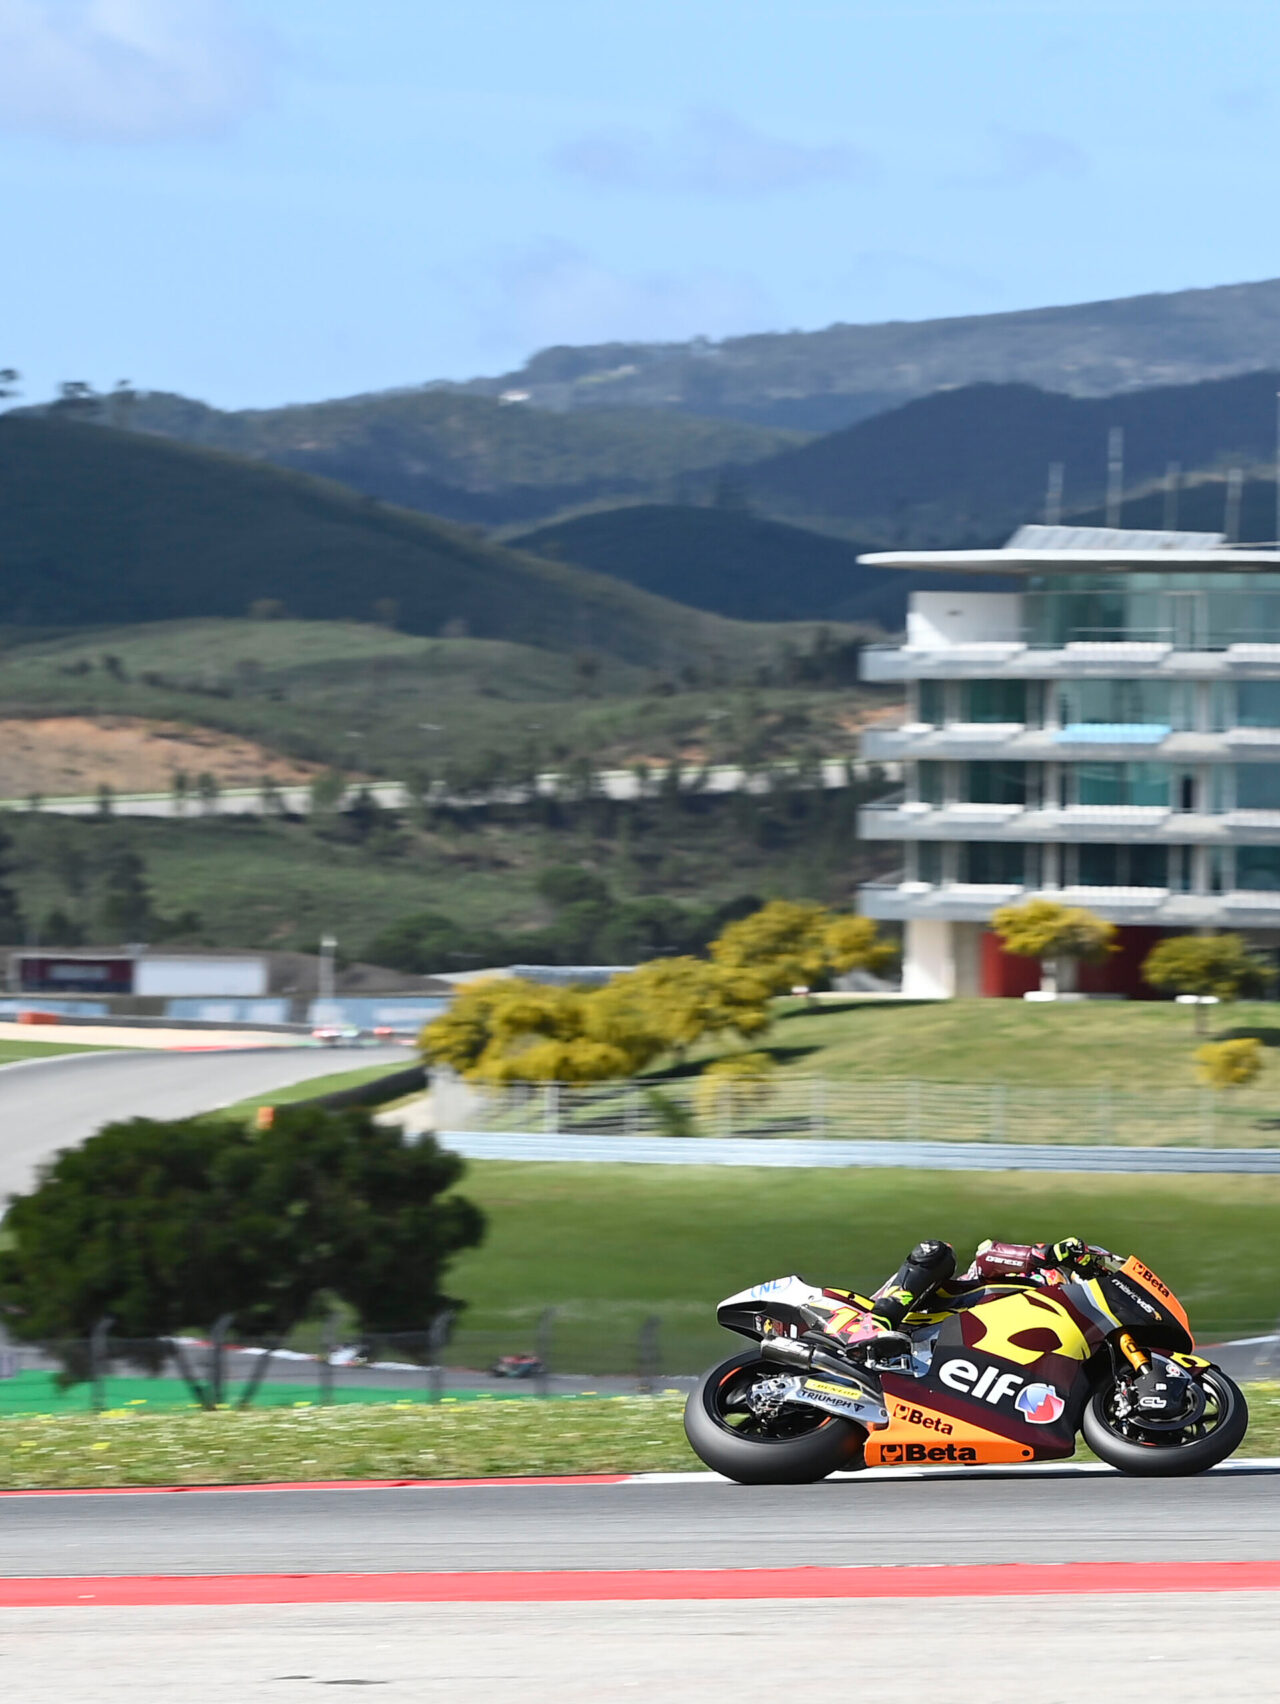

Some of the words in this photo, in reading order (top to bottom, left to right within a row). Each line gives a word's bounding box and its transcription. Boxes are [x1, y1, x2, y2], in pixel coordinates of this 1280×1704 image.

[1142, 1269, 1170, 1298] Beta
[939, 1359, 1024, 1404] elf
[801, 1390, 852, 1408] TRIUMPH
[908, 1409, 953, 1435] Beta
[906, 1443, 976, 1462] Beta
